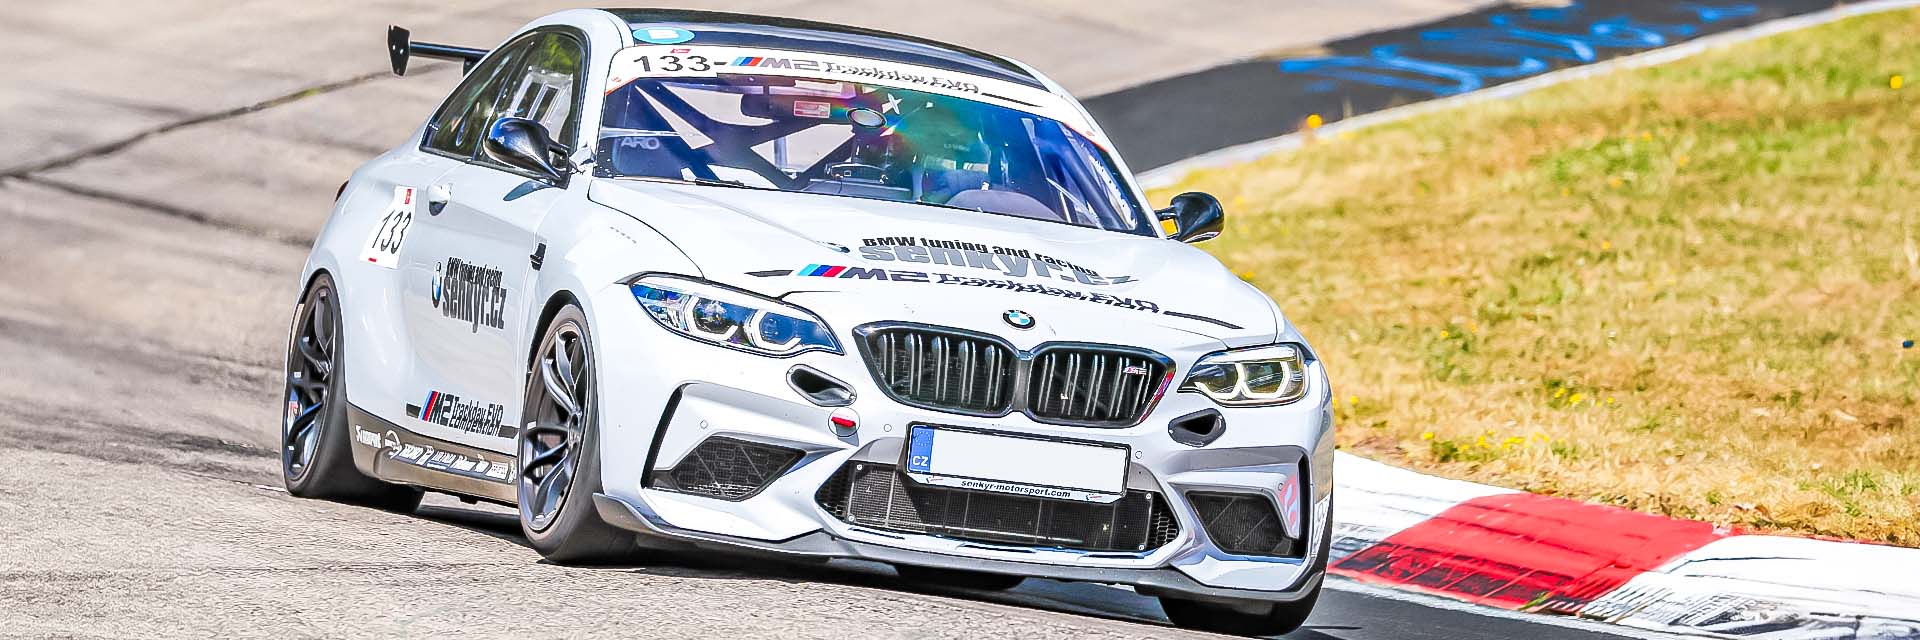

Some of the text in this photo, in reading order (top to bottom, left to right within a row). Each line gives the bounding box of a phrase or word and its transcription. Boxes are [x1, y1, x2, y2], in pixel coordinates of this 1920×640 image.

[633, 55, 711, 72] 133
[371, 209, 412, 255] 133
[838, 267, 931, 283] M2
[862, 236, 1099, 278] BMW tuning and racing
[442, 275, 508, 333] senkyr.cz
[429, 391, 455, 427] M2
[912, 455, 929, 467] CZ
